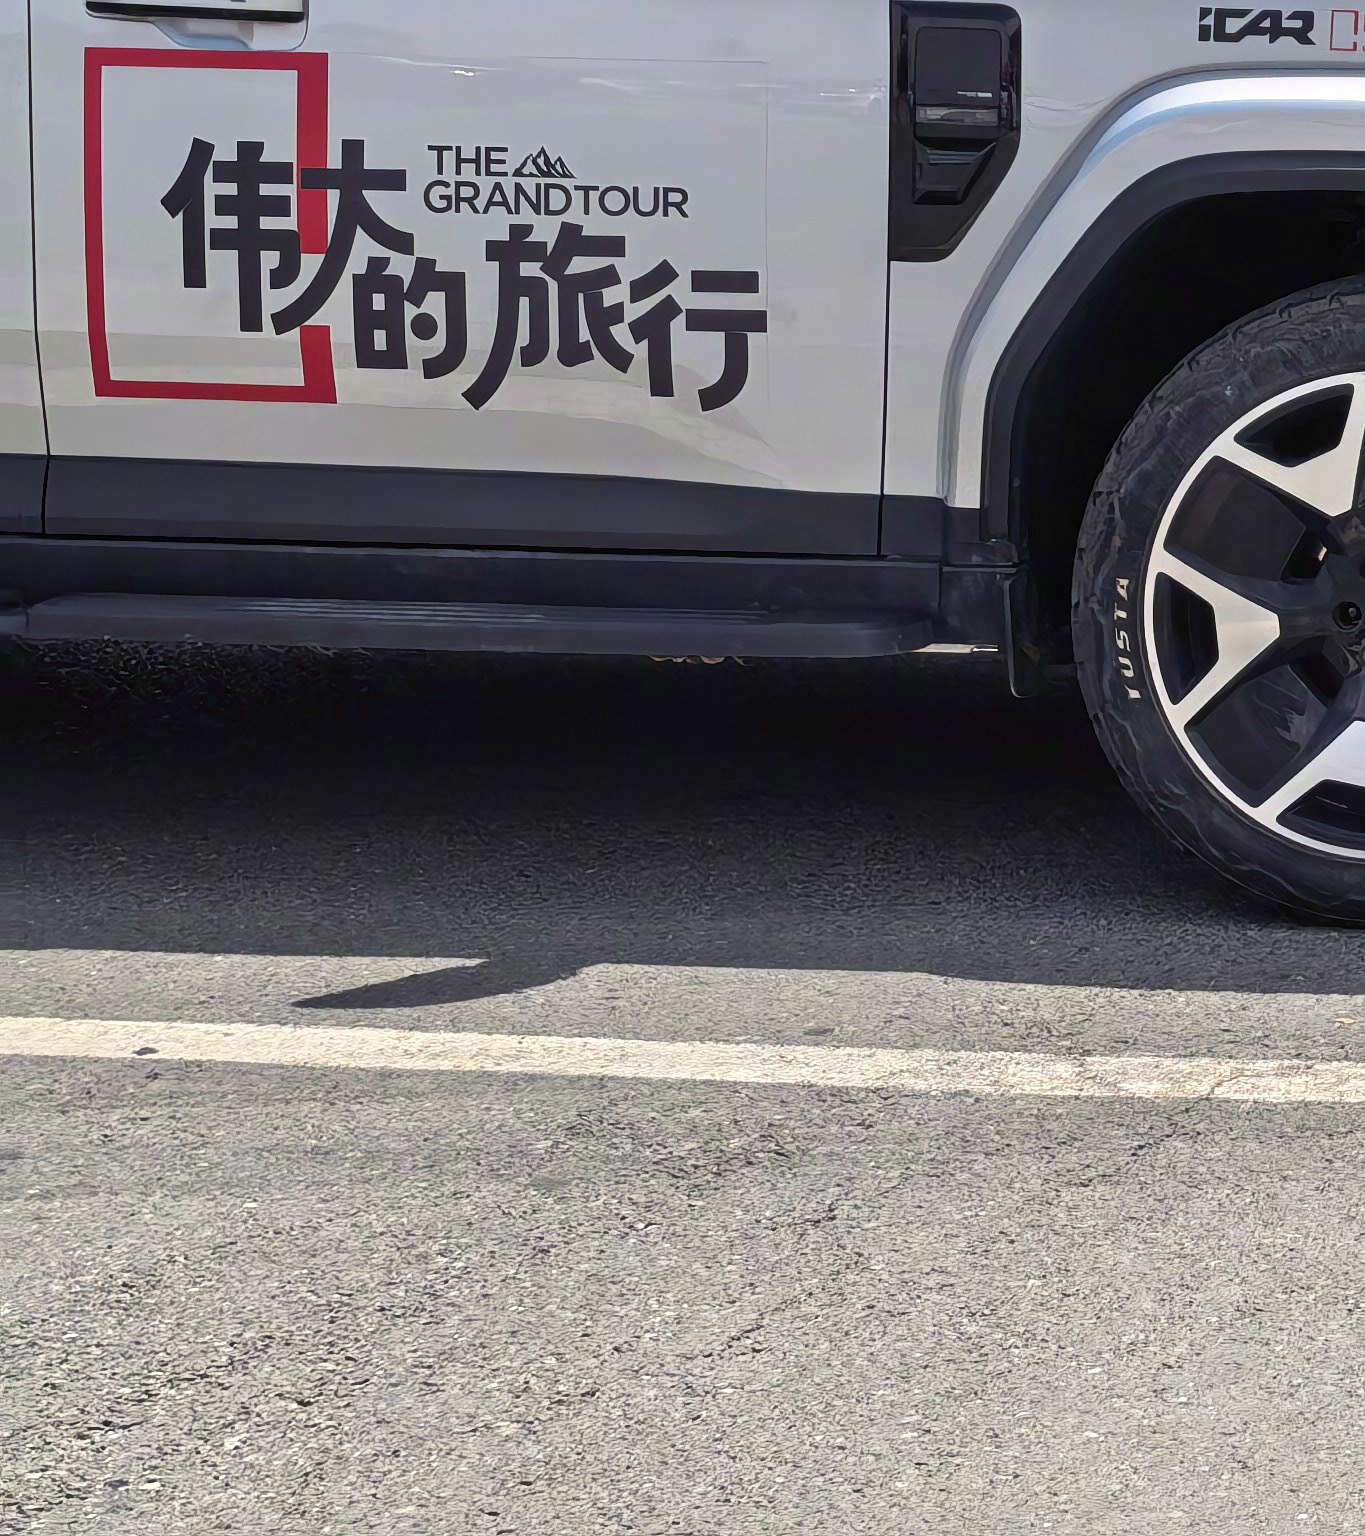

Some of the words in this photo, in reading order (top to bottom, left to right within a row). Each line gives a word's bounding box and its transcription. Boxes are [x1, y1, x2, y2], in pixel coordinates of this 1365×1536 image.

[427, 145, 509, 177] THE
[423, 180, 690, 218] GRANDTOUR
[1114, 577, 1142, 700] YUSTA
